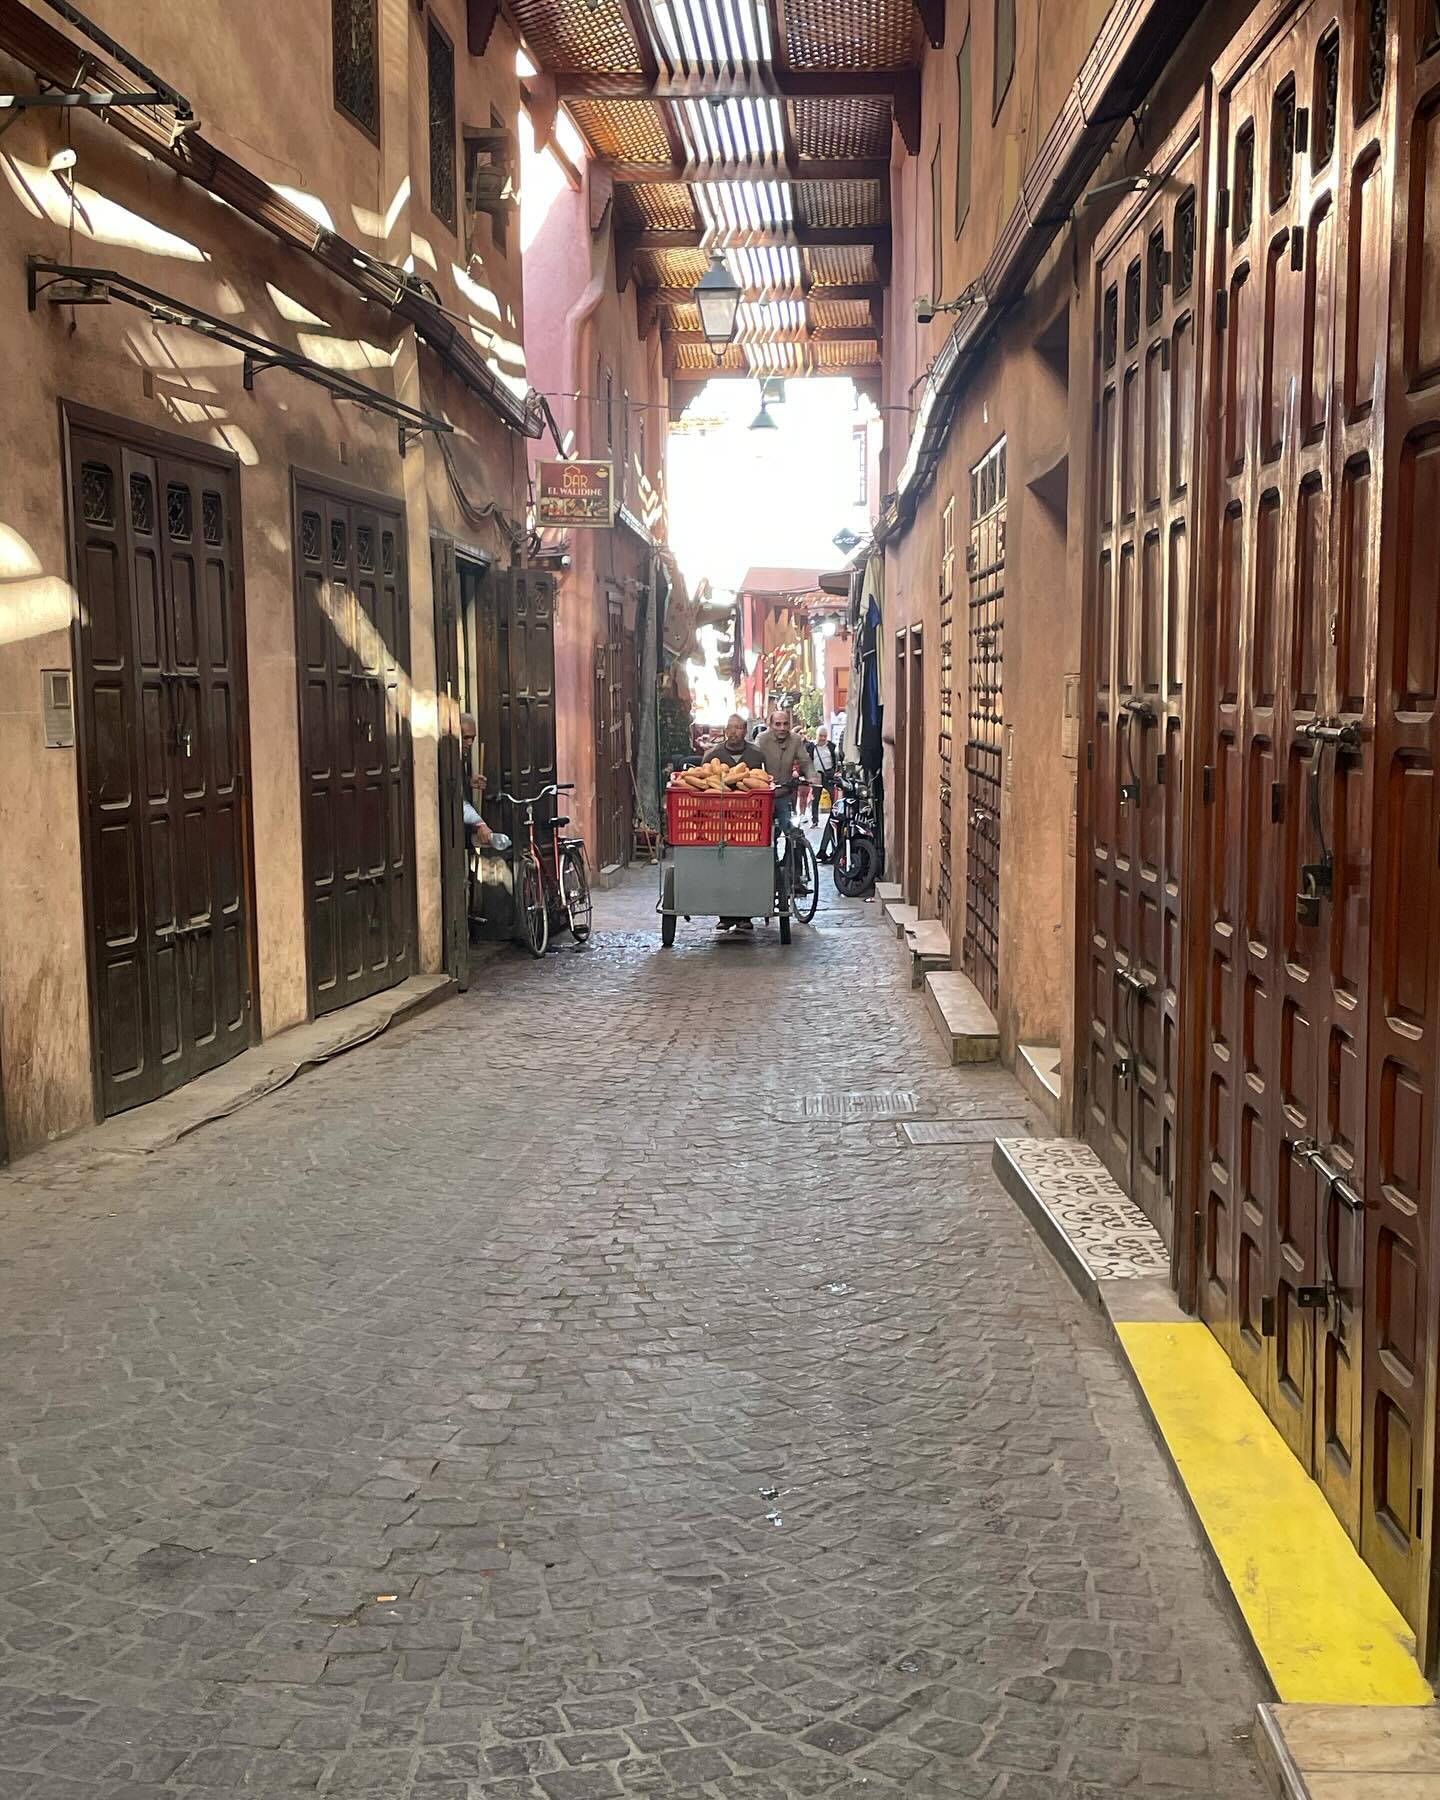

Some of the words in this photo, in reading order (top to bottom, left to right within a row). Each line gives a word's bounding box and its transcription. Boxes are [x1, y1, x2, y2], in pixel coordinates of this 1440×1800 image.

[563, 474, 588, 488] DAR
[547, 487, 558, 495] EL
[560, 487, 602, 496] WALIDINE
